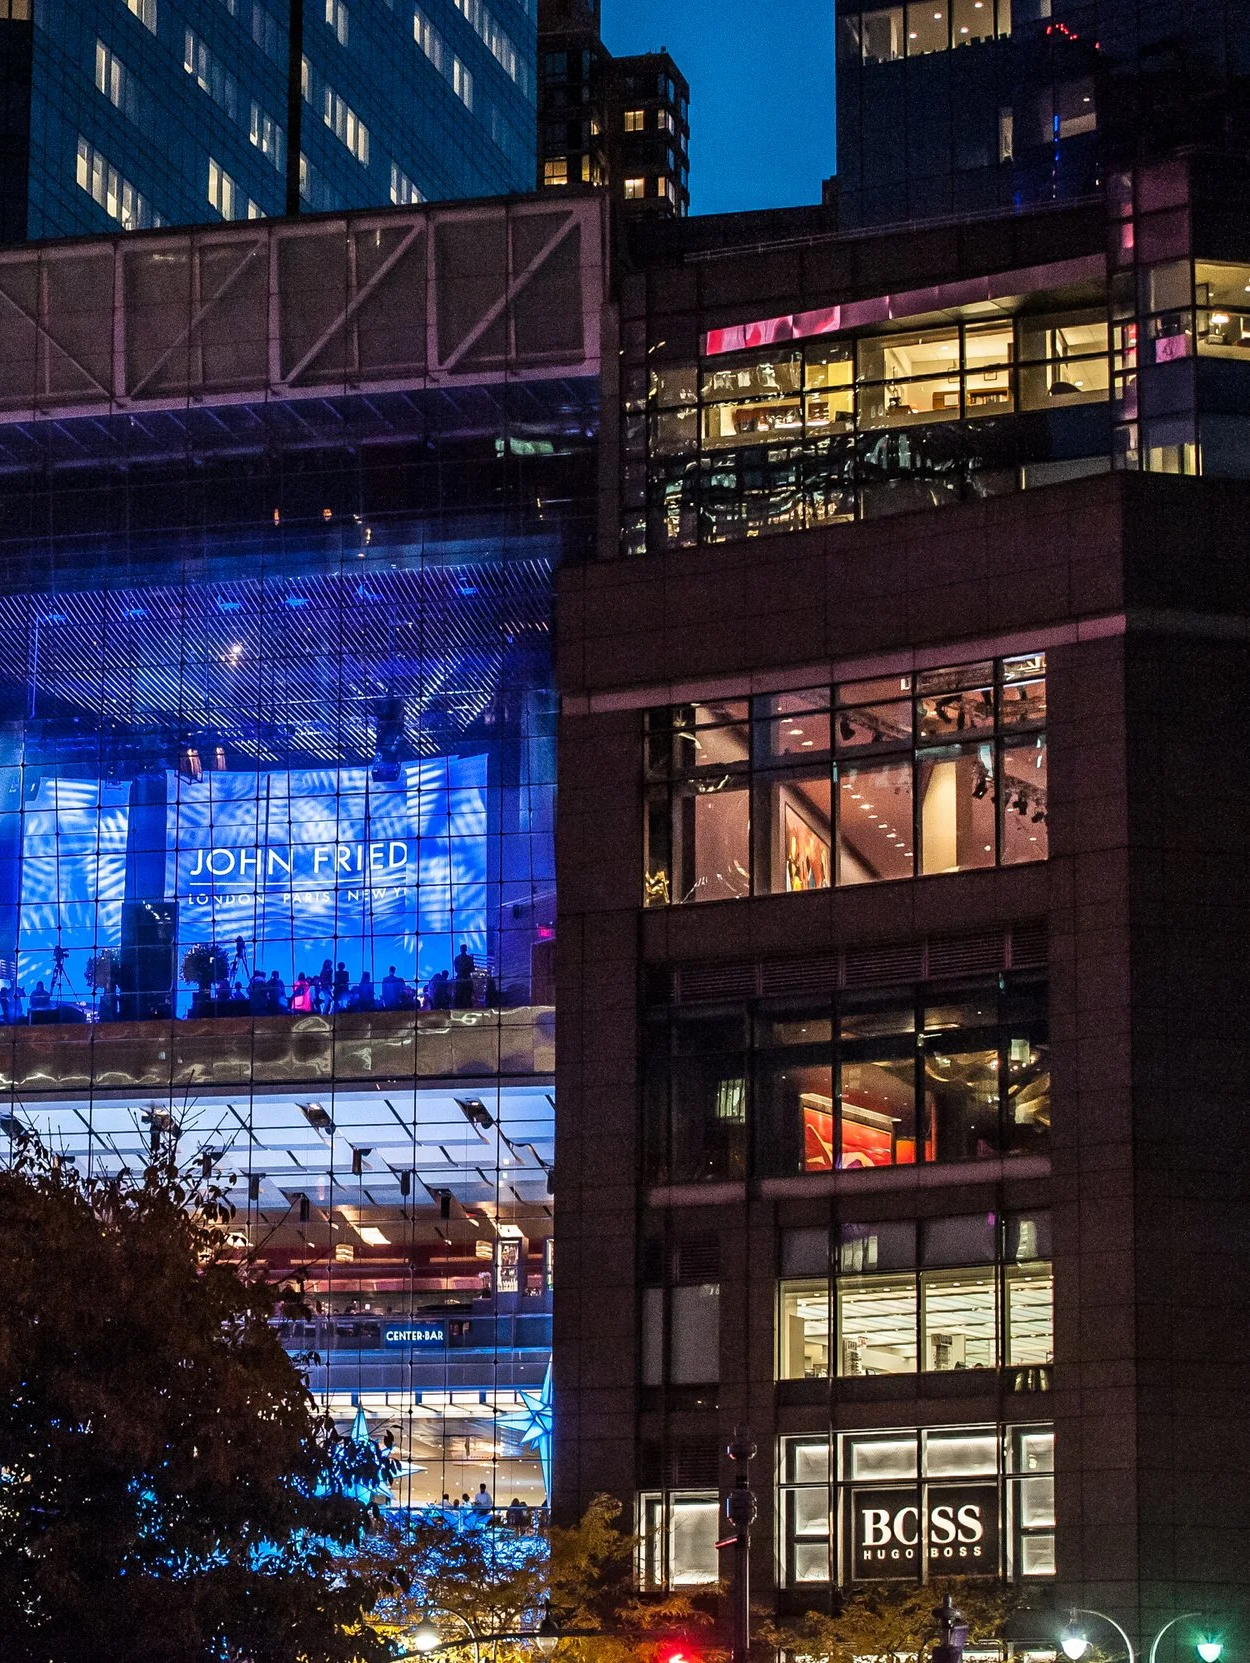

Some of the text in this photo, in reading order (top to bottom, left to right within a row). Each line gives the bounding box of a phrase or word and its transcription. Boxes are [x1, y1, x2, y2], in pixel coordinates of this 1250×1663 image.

[190, 841, 408, 876] JOHN FRIED
[188, 892, 265, 905] LONDON
[283, 891, 330, 904] PARIS
[347, 887, 387, 901] NEW
[861, 1504, 984, 1546] BOSS
[863, 1546, 982, 1561] HUGO BOSS
